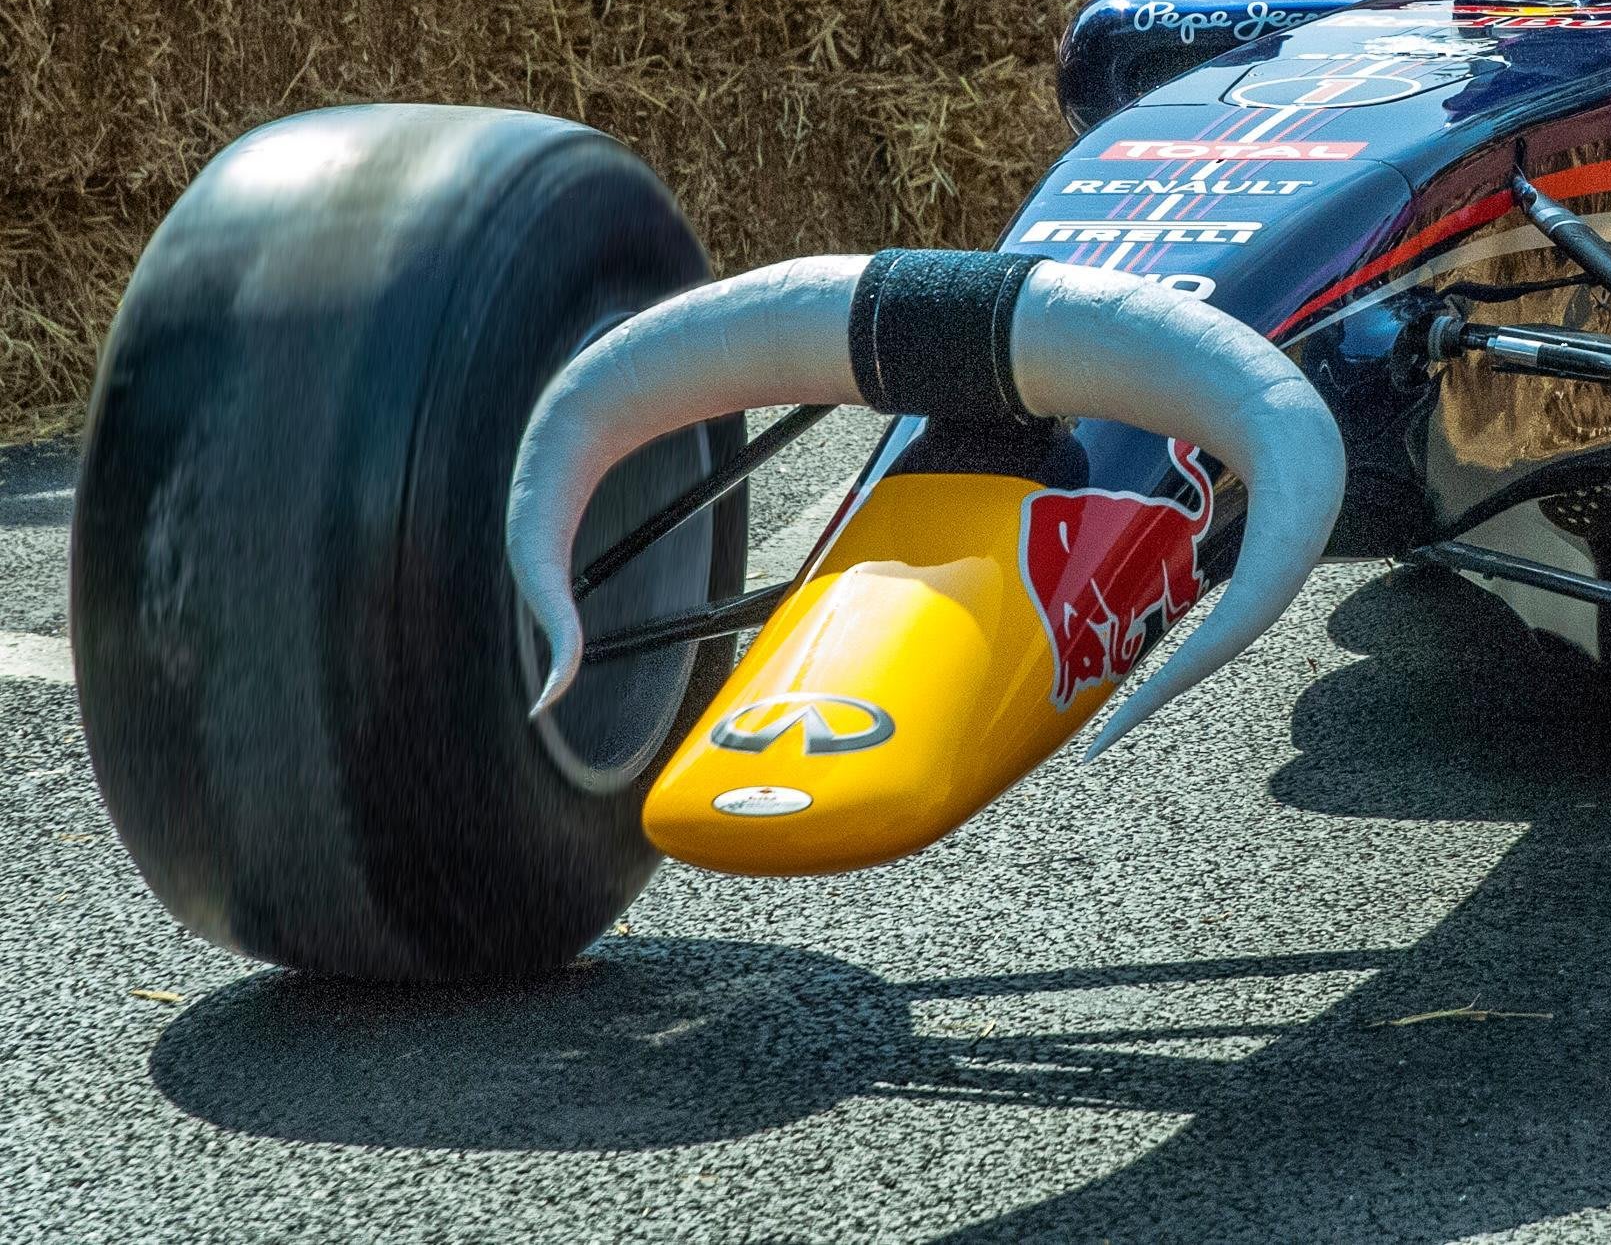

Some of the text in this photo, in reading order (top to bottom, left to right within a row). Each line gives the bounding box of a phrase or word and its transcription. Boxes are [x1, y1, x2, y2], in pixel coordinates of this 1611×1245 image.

[1134, 1, 1232, 44] Pepe
[1117, 140, 1356, 159] TOTAL
[1061, 179, 1314, 195] RENAULT
[1019, 220, 1263, 243] PIRELLI
